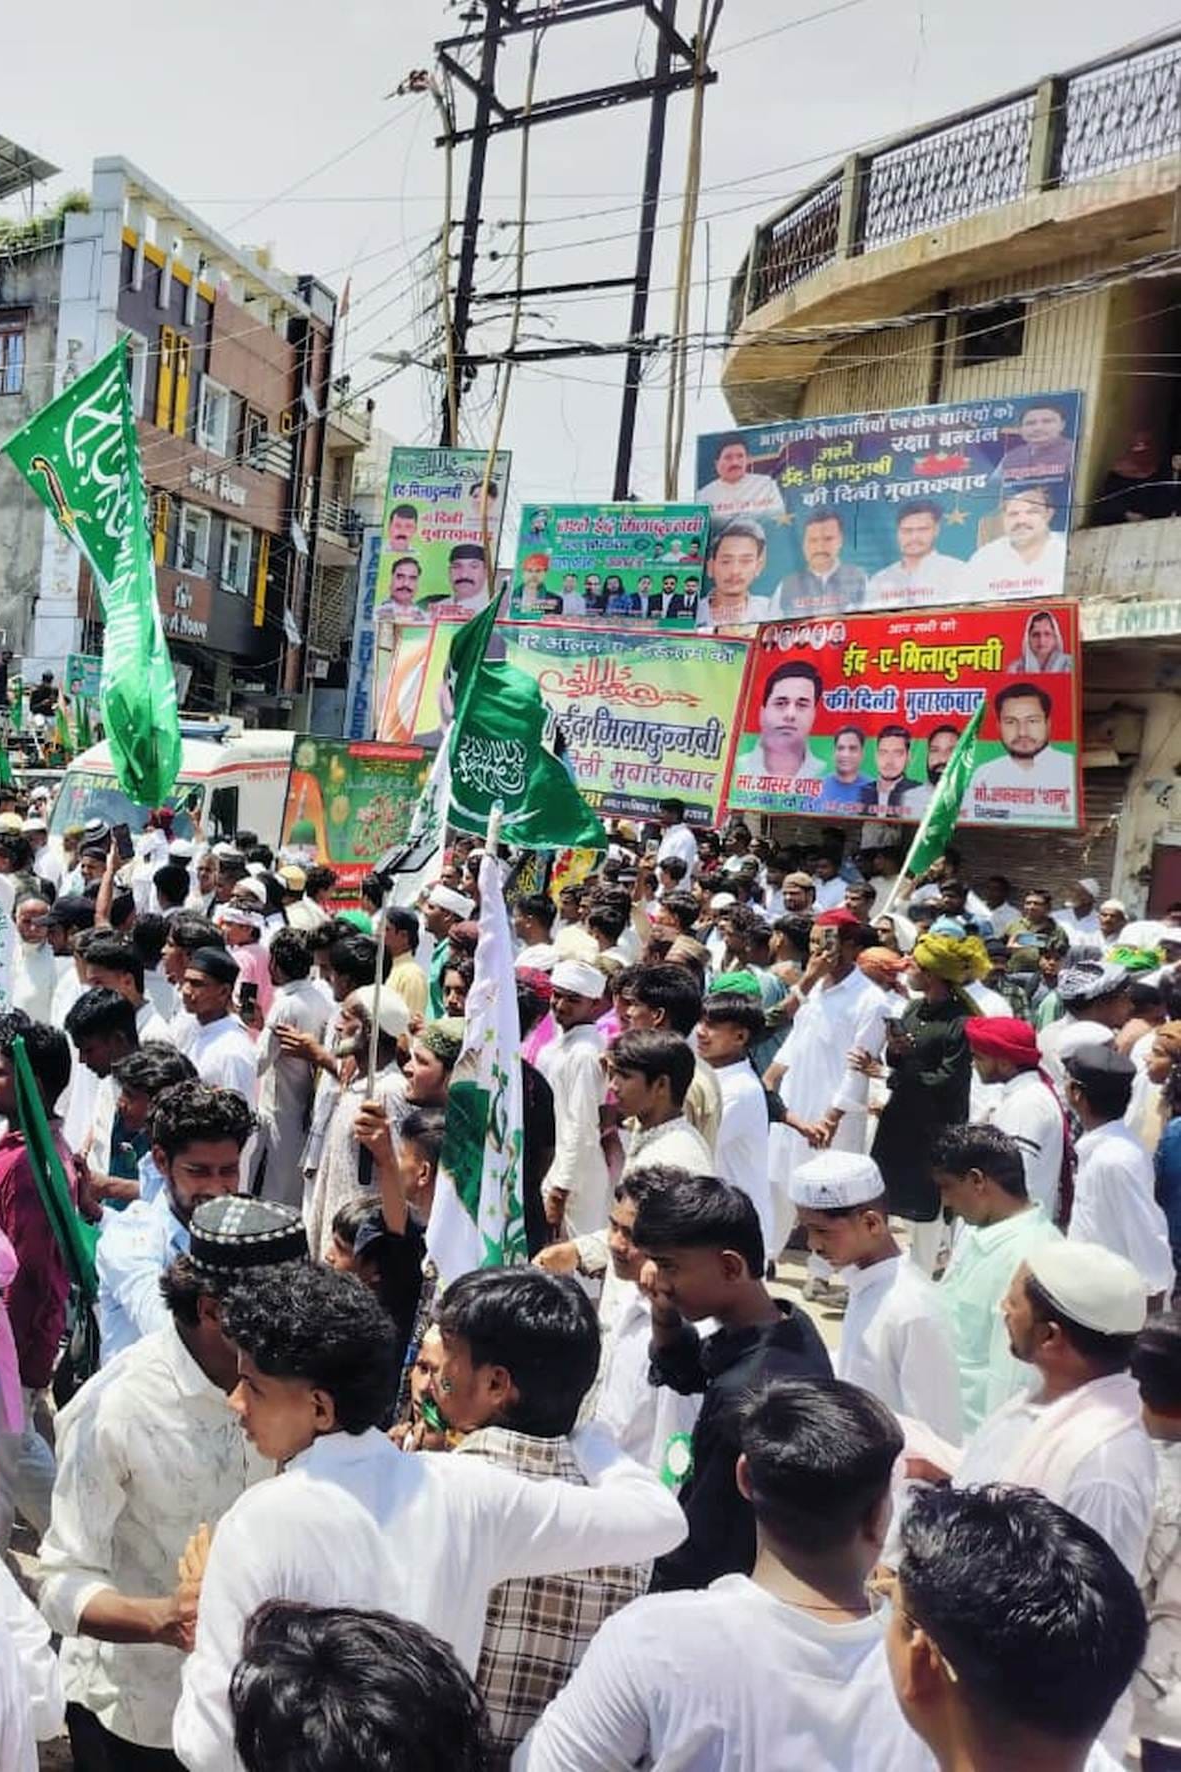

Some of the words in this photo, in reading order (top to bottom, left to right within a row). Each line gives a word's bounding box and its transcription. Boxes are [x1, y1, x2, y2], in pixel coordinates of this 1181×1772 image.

[993, 402, 1015, 420] को
[891, 433, 931, 453] रक्षा
[803, 486, 829, 508] की
[834, 481, 879, 504] दिली
[823, 685, 852, 713] की
[854, 684, 899, 714] दिली
[610, 761, 718, 791] मुबारकबाद
